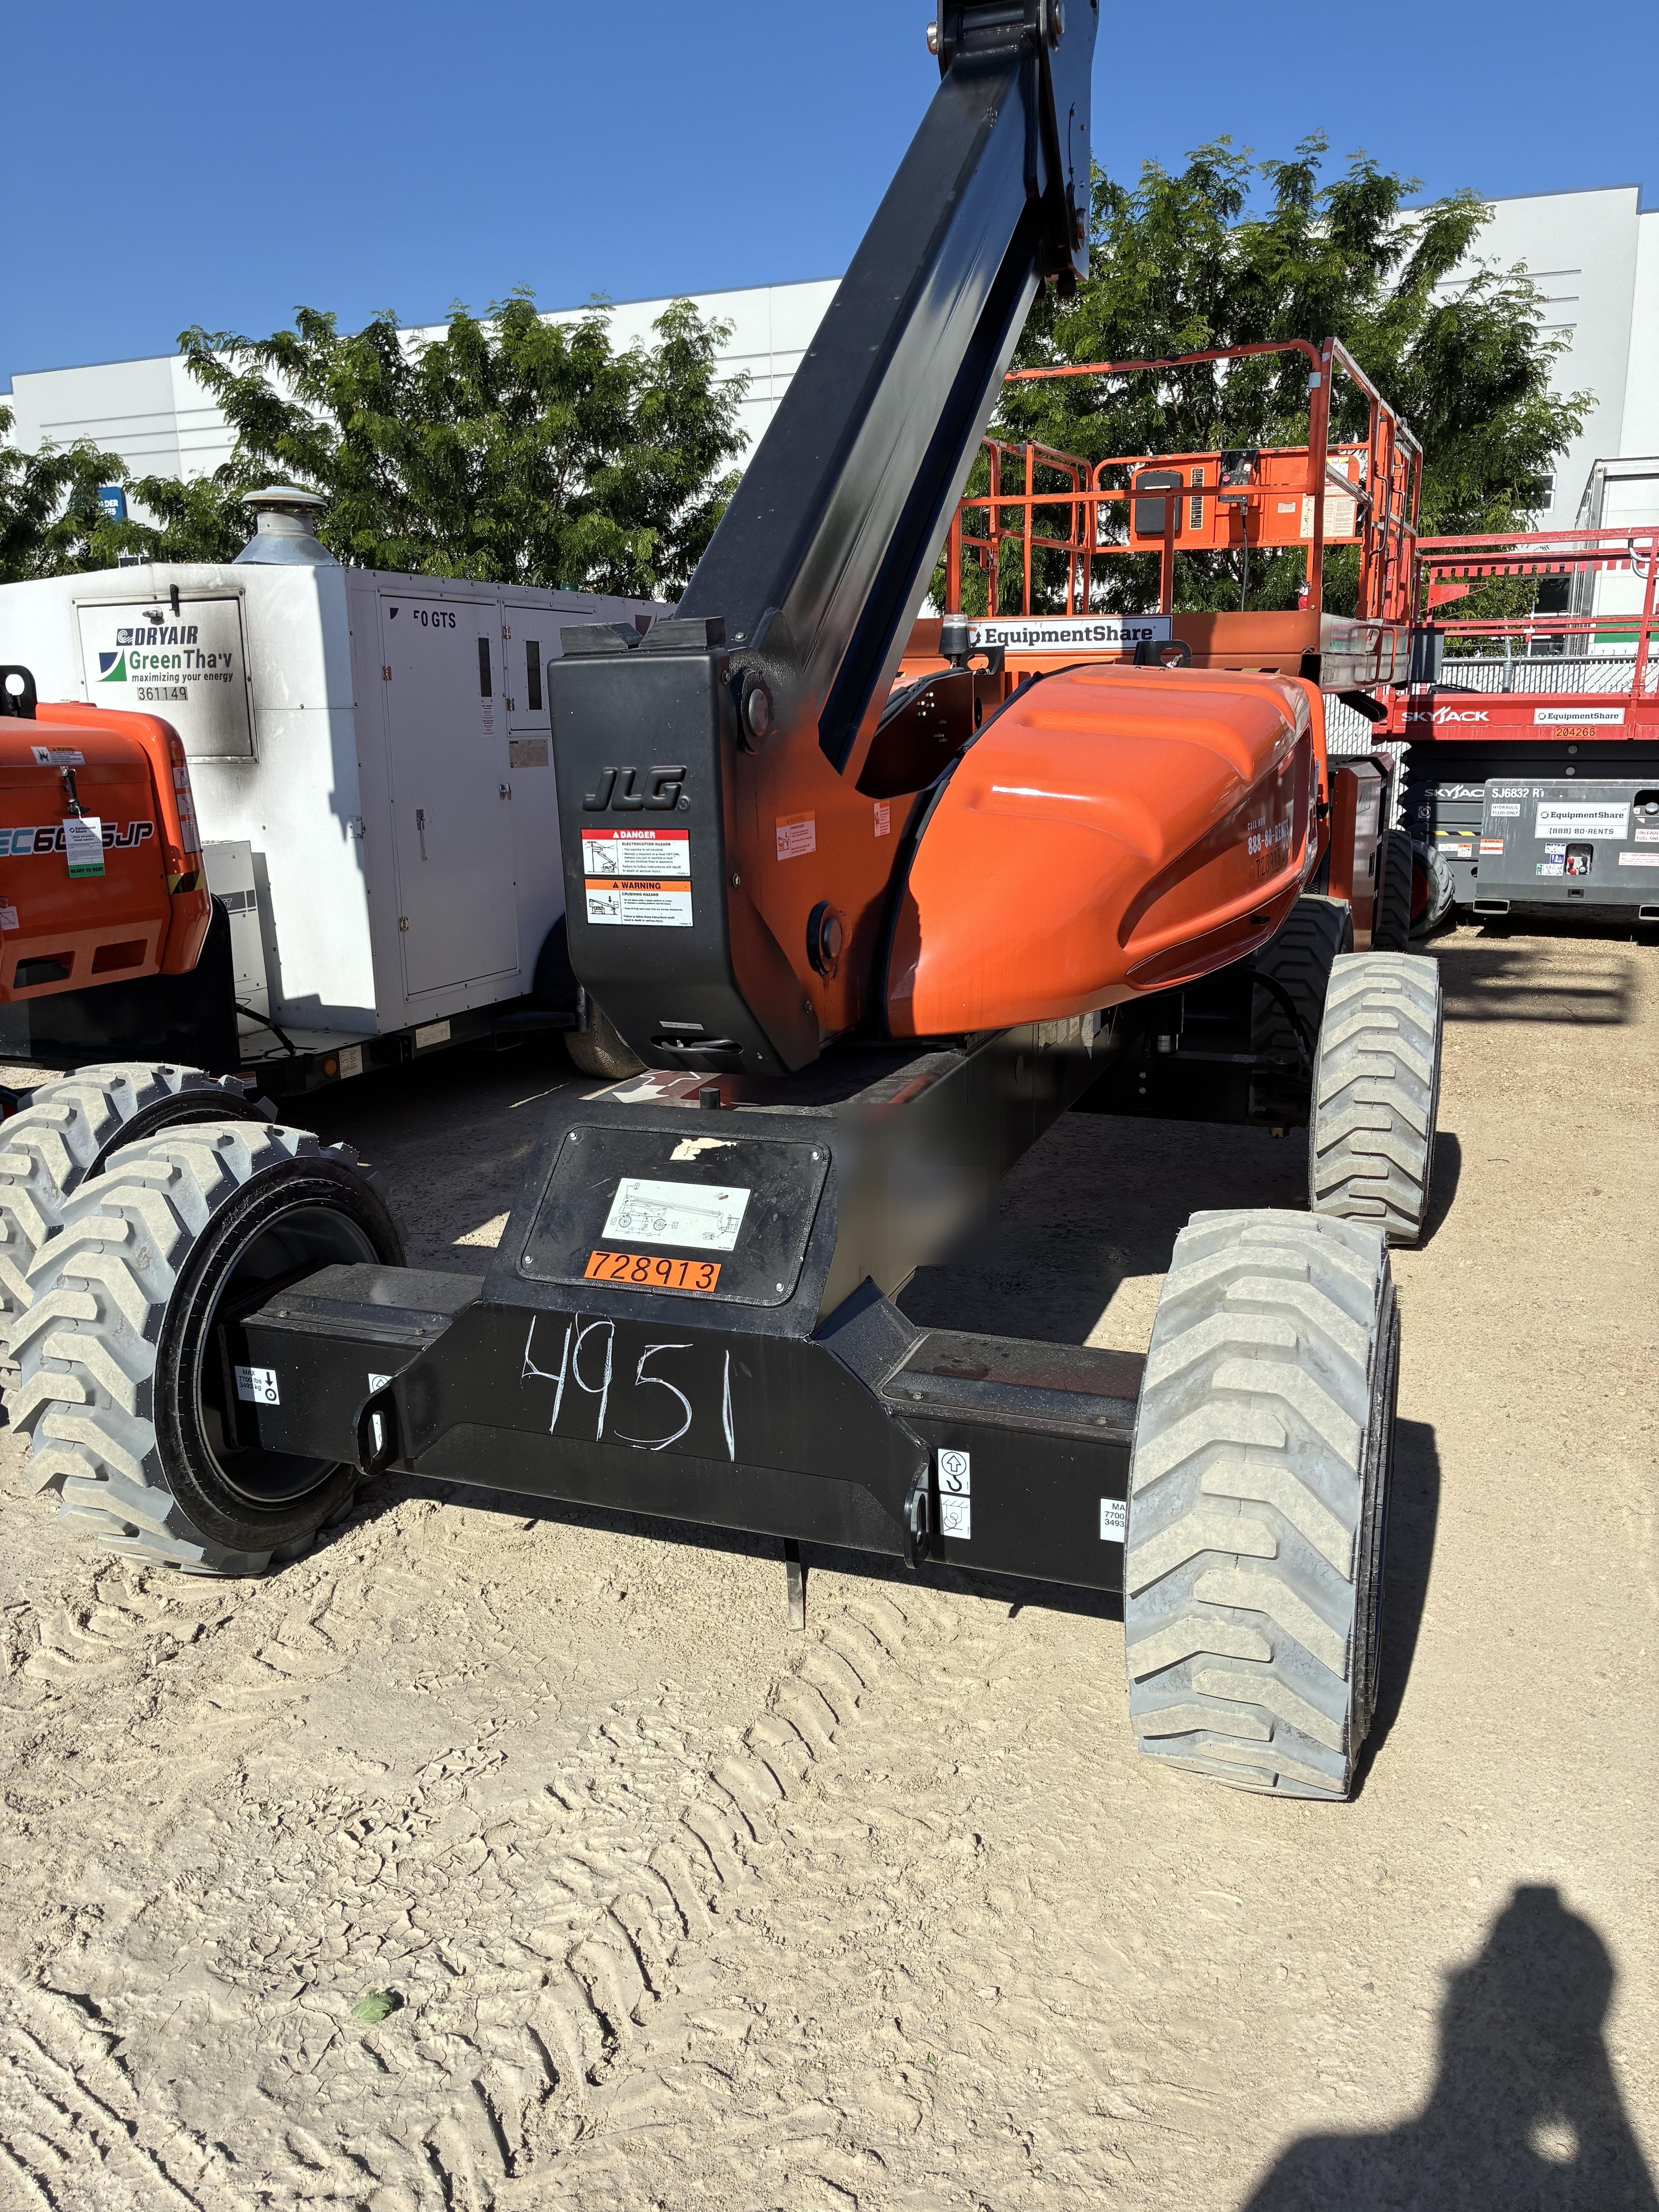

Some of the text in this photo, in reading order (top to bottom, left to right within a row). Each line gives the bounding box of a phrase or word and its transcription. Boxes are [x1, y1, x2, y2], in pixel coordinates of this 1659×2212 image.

[432, 611, 456, 628] GTS
[135, 626, 198, 646] DRYAIR
[985, 626, 1153, 647] EquipmentShare
[132, 672, 233, 683] maximizing your energy
[138, 687, 187, 701] 361149
[1401, 706, 1490, 725] SKYJACK
[1548, 712, 1619, 721] EquipmentShare
[1556, 727, 1595, 737] 204266
[582, 766, 687, 812] JLG
[1424, 785, 1484, 799] SKYJAC
[1492, 788, 1529, 798] SJ6832
[620, 831, 656, 839] DANGER
[592, 1252, 714, 1289] 728913
[521, 1311, 735, 1462] 4951
[1112, 1503, 1126, 1511] MA
[1105, 1511, 1125, 1520] 7700
[1105, 1519, 1125, 1527] 3493
